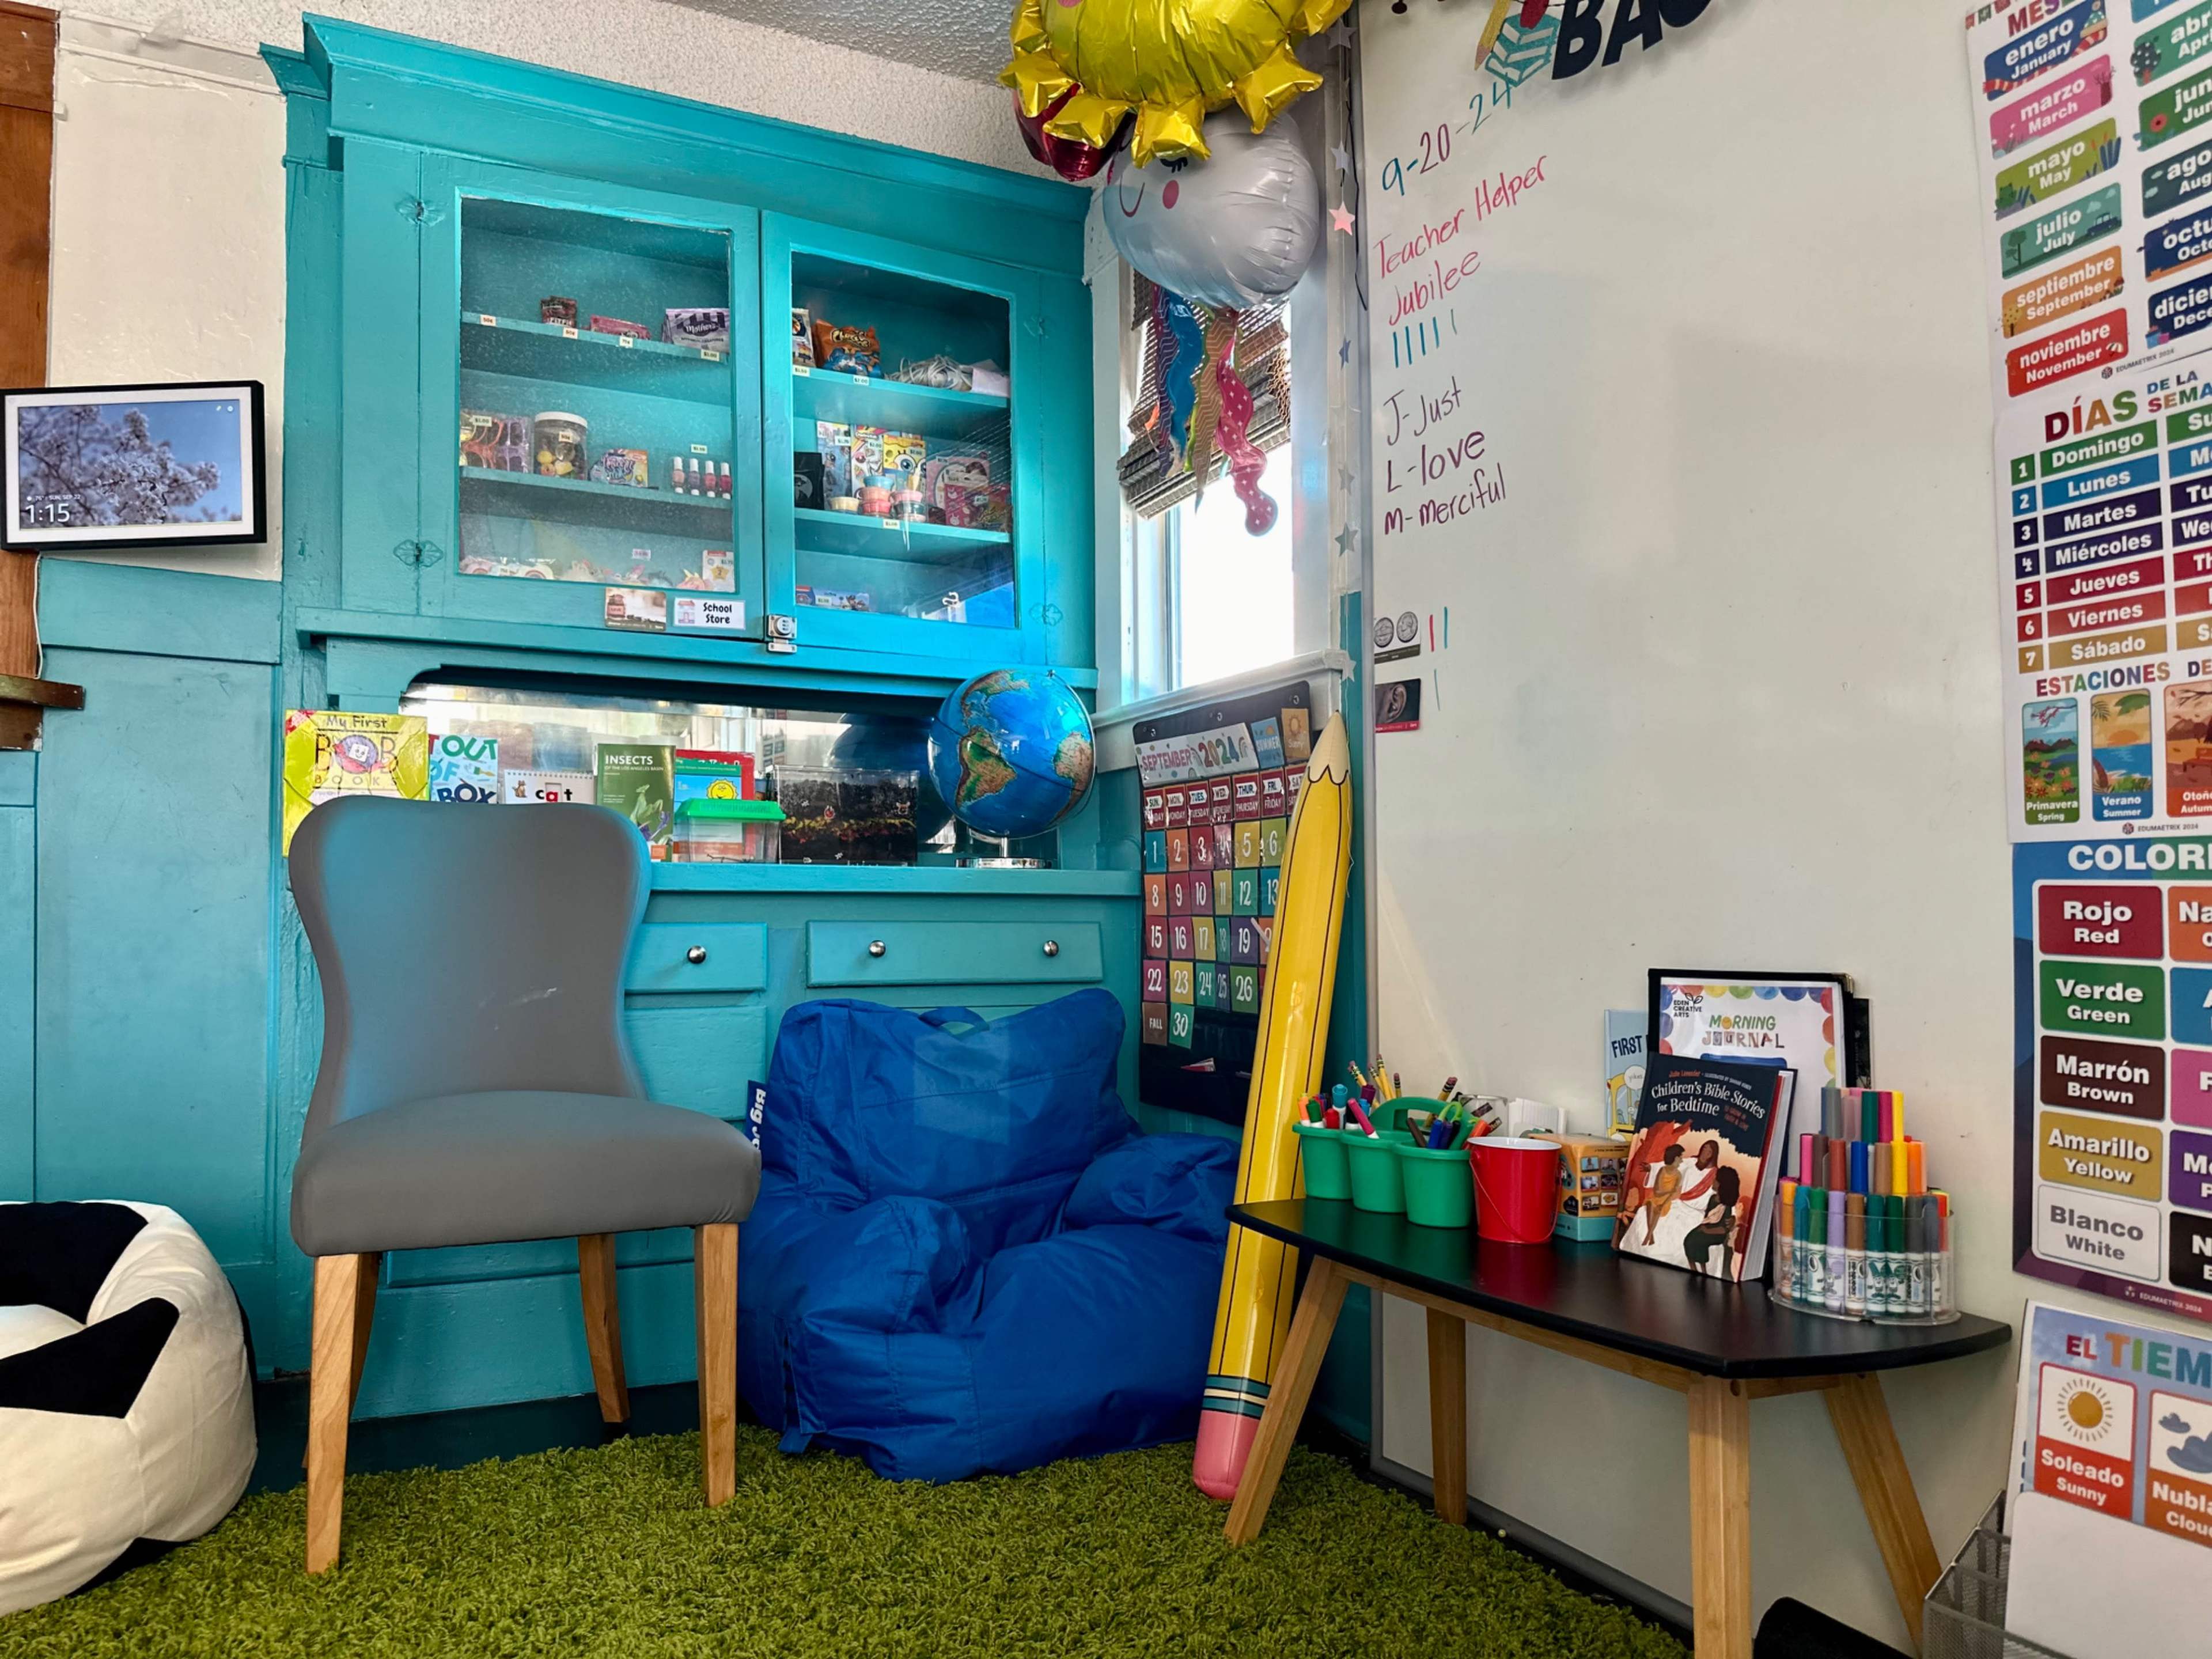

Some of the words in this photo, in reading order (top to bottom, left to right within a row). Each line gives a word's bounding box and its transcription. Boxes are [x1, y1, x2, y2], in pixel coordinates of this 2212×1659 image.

[2005, 18, 2073, 66] enero
[2011, 39, 2072, 79] January
[2020, 78, 2085, 121] marzo
[2029, 101, 2078, 134] March
[1382, 73, 1512, 196] 9-20-24
[2028, 141, 2085, 179] mayo
[2039, 166, 2073, 190] May
[1373, 209, 1464, 279] Teacher
[1475, 156, 1547, 221] Helper
[2036, 209, 2082, 244] julio
[2043, 230, 2076, 253] July
[1389, 252, 1480, 326] Jubilee
[2017, 257, 2115, 308] septiembre
[2027, 279, 2111, 321] September
[2020, 324, 2111, 369] noviembre
[2027, 348, 2102, 384] November
[2147, 377, 2170, 394] DE
[2176, 370, 2198, 386] LA
[2045, 390, 2138, 443] DÍAS
[2018, 463, 2028, 478] 1
[2052, 432, 2144, 468] Domingo
[2020, 495, 2030, 509] 2
[2068, 470, 2131, 498] Lunes
[25, 503, 70, 523] 1:15
[2021, 526, 2031, 540] 3
[2064, 503, 2137, 532] Martes
[2022, 558, 2032, 572] 4
[2055, 533, 2152, 566] Miércoles
[2024, 588, 2033, 604] 5
[2070, 570, 2140, 595] Jueves
[703, 602, 732, 613] School
[706, 614, 730, 624] Store
[2025, 620, 2035, 635] 6
[2067, 604, 2143, 628] Viernes
[2026, 652, 2036, 667] 7
[2071, 635, 2145, 661] Sábado
[2036, 662, 2171, 698] ESTACIONES
[327, 715, 346, 728] My
[353, 715, 387, 728] First
[442, 734, 498, 761] OUT
[1142, 749, 1192, 771] SEPTEMBER
[1199, 736, 1238, 768] 2024
[1256, 737, 1280, 751] SUMMER
[1288, 738, 1304, 749] Sunny
[605, 755, 653, 765] INSECTS
[437, 782, 497, 803] BOX
[535, 789, 573, 802] cat
[1236, 801, 1259, 812] THURSDAY
[1264, 797, 1282, 809] FRIDAY
[2026, 800, 2078, 811] Primavera
[2102, 796, 2141, 806] Verano
[2037, 813, 2065, 822] Spring
[2103, 809, 2142, 818] Summer
[1153, 840, 1157, 863] 1
[1173, 839, 1181, 862] 2
[1198, 837, 1206, 860] 3
[1243, 832, 1251, 857] 5
[1270, 830, 1278, 856] 6
[2068, 843, 2212, 871] COLOR
[1152, 885, 1158, 907] 8
[1175, 884, 1183, 906] 9
[1195, 882, 1206, 906] 10
[1220, 882, 1226, 904] 11
[1240, 881, 1251, 906] 12
[1267, 879, 1279, 904] 13
[2063, 901, 2133, 926] Rojo
[1151, 925, 1162, 948] 15
[1175, 926, 1187, 950] 16
[1199, 927, 1209, 950] 17
[1219, 927, 1226, 951] 18
[1238, 928, 1250, 954] 19
[2074, 928, 2119, 944] Red
[1147, 969, 1162, 991] 22
[1175, 970, 1188, 994] 23
[1199, 972, 1212, 997] 24
[1218, 975, 1226, 999] 25
[1236, 976, 1252, 1001] 26
[2056, 979, 2143, 1003] Verde
[1149, 1018, 1162, 1030] FALL
[1173, 1013, 1188, 1036] 30
[1709, 1014, 1776, 1031] MORNING
[2067, 1005, 2130, 1024] Green
[1611, 1035, 1642, 1058] FIRST
[1702, 1031, 1785, 1049] JOURNAL
[2056, 1054, 2150, 1084] Marrón
[1651, 1081, 1702, 1099] Children's
[1705, 1082, 1730, 1100] Bible
[1731, 1090, 1766, 1119] Stories
[1657, 1102, 1668, 1112] for
[1671, 1096, 1719, 1116] Bedtime
[2067, 1082, 2134, 1104] Brown
[2048, 1128, 2150, 1162] Amarillo
[2064, 1157, 2133, 1184] Yellow
[2050, 1205, 2143, 1241] Blanco
[2065, 1234, 2125, 1260] White
[2066, 1334, 2097, 1360] EL
[2041, 1449, 2125, 1488] Soleado
[2056, 1476, 2107, 1506] Sunny
